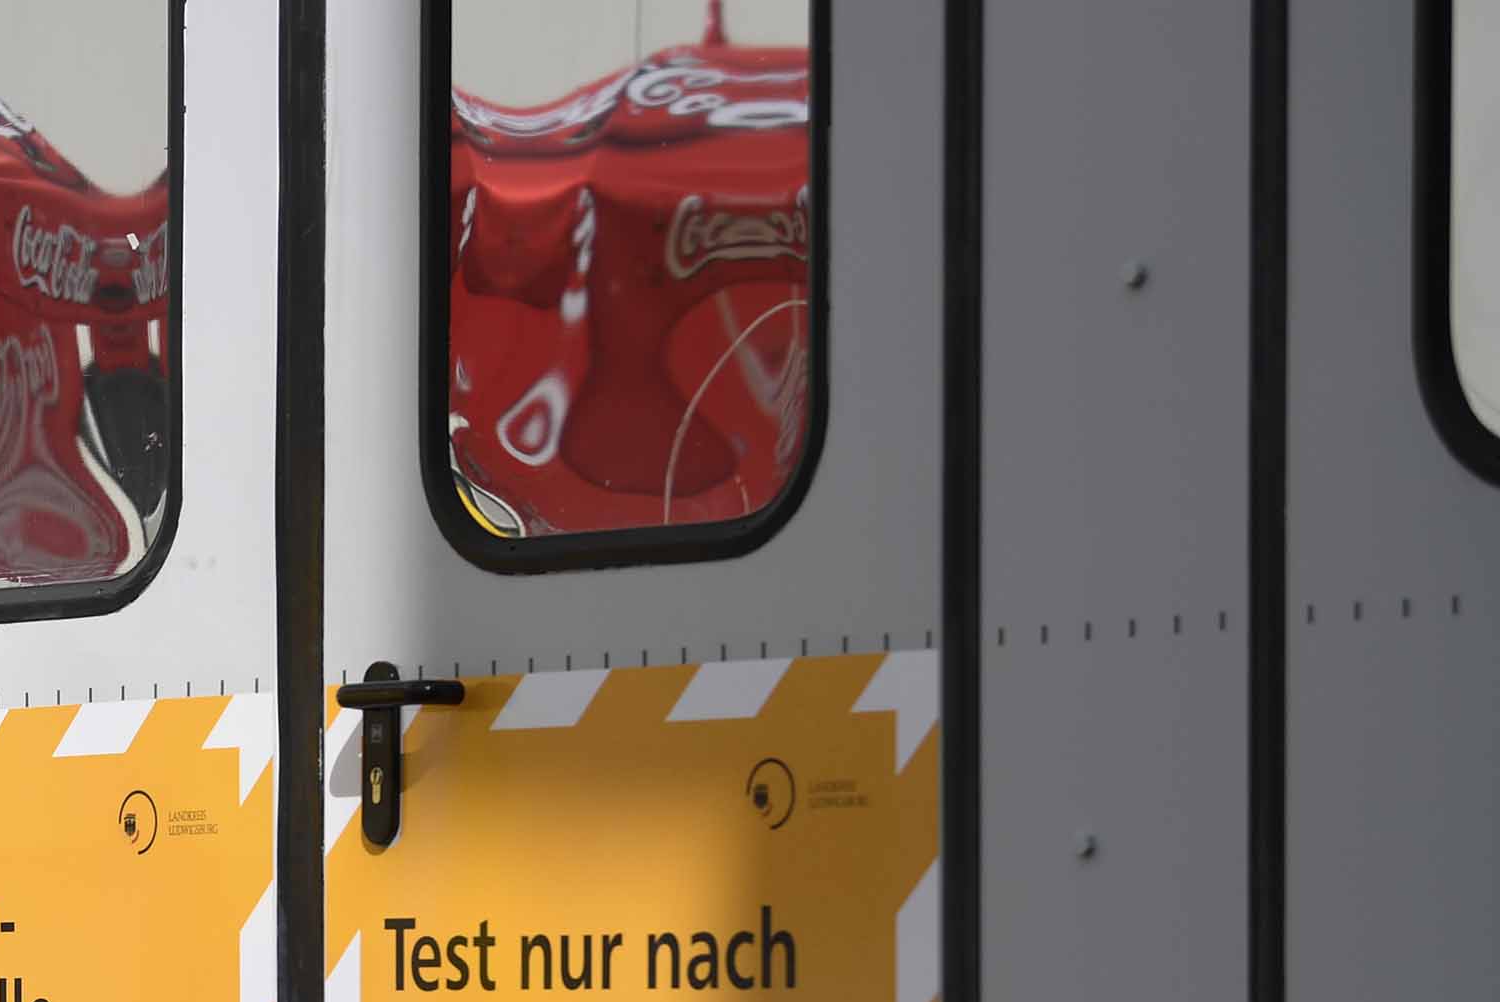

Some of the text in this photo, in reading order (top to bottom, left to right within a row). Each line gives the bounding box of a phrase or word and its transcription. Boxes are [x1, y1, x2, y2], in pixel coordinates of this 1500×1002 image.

[384, 905, 797, 992] Test nur nach
